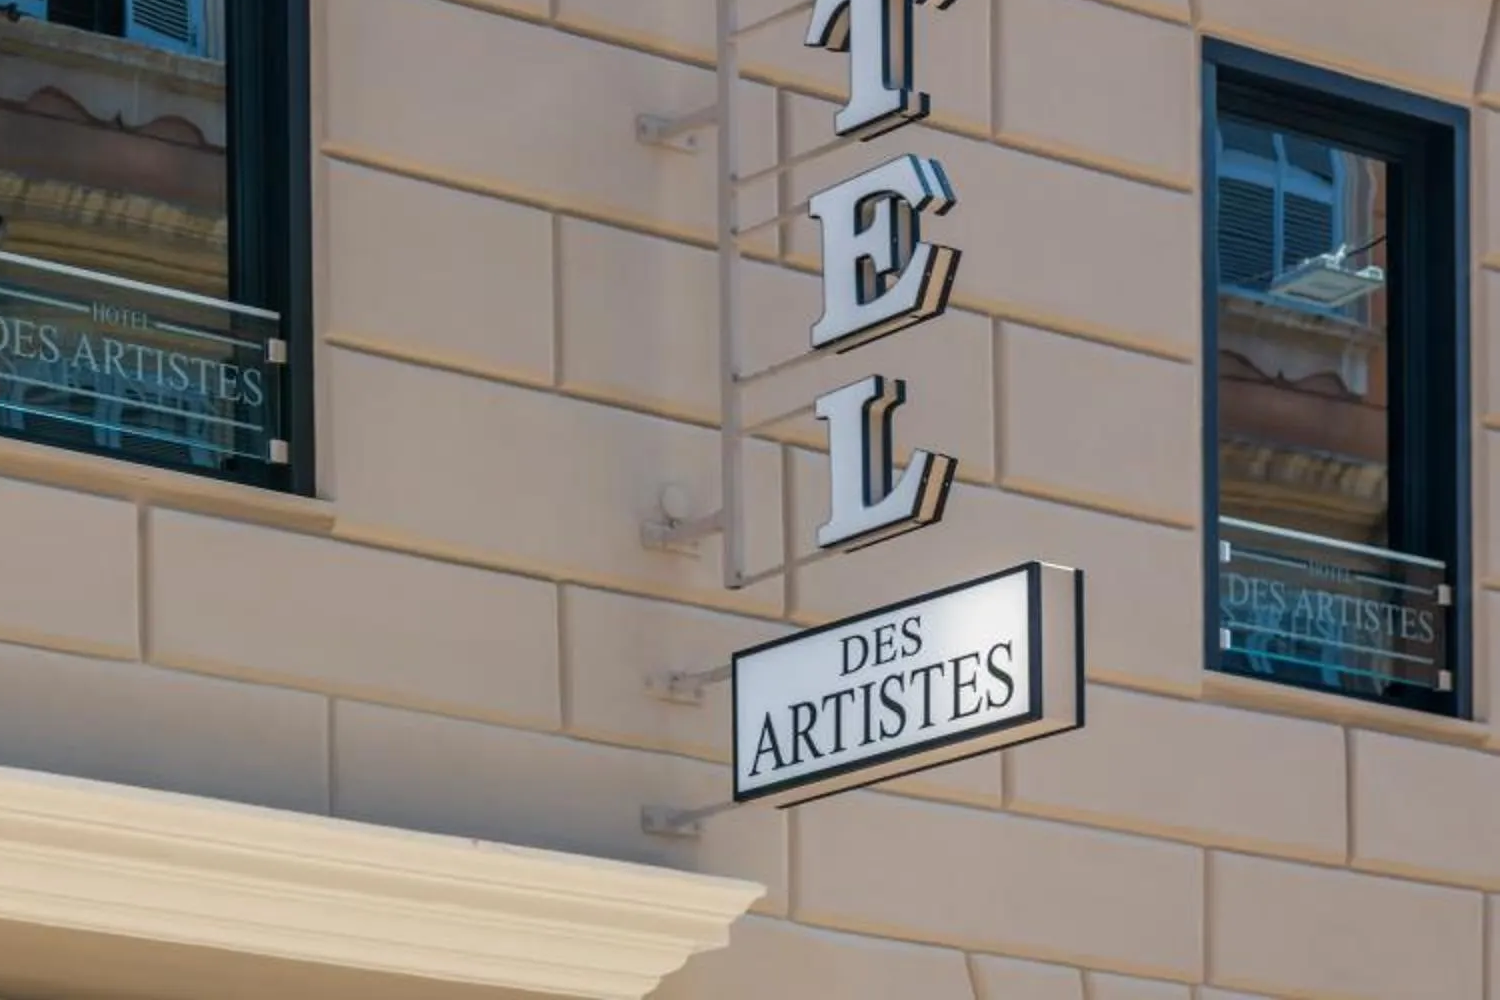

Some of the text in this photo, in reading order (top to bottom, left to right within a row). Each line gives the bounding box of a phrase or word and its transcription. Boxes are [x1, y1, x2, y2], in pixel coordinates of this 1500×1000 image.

[92, 301, 152, 330] HOTEL
[70, 332, 264, 406] ARTISTES
[1227, 572, 1436, 643] DES ARTISTES
[838, 615, 924, 677] DES
[747, 639, 1016, 777] ARTISTES
